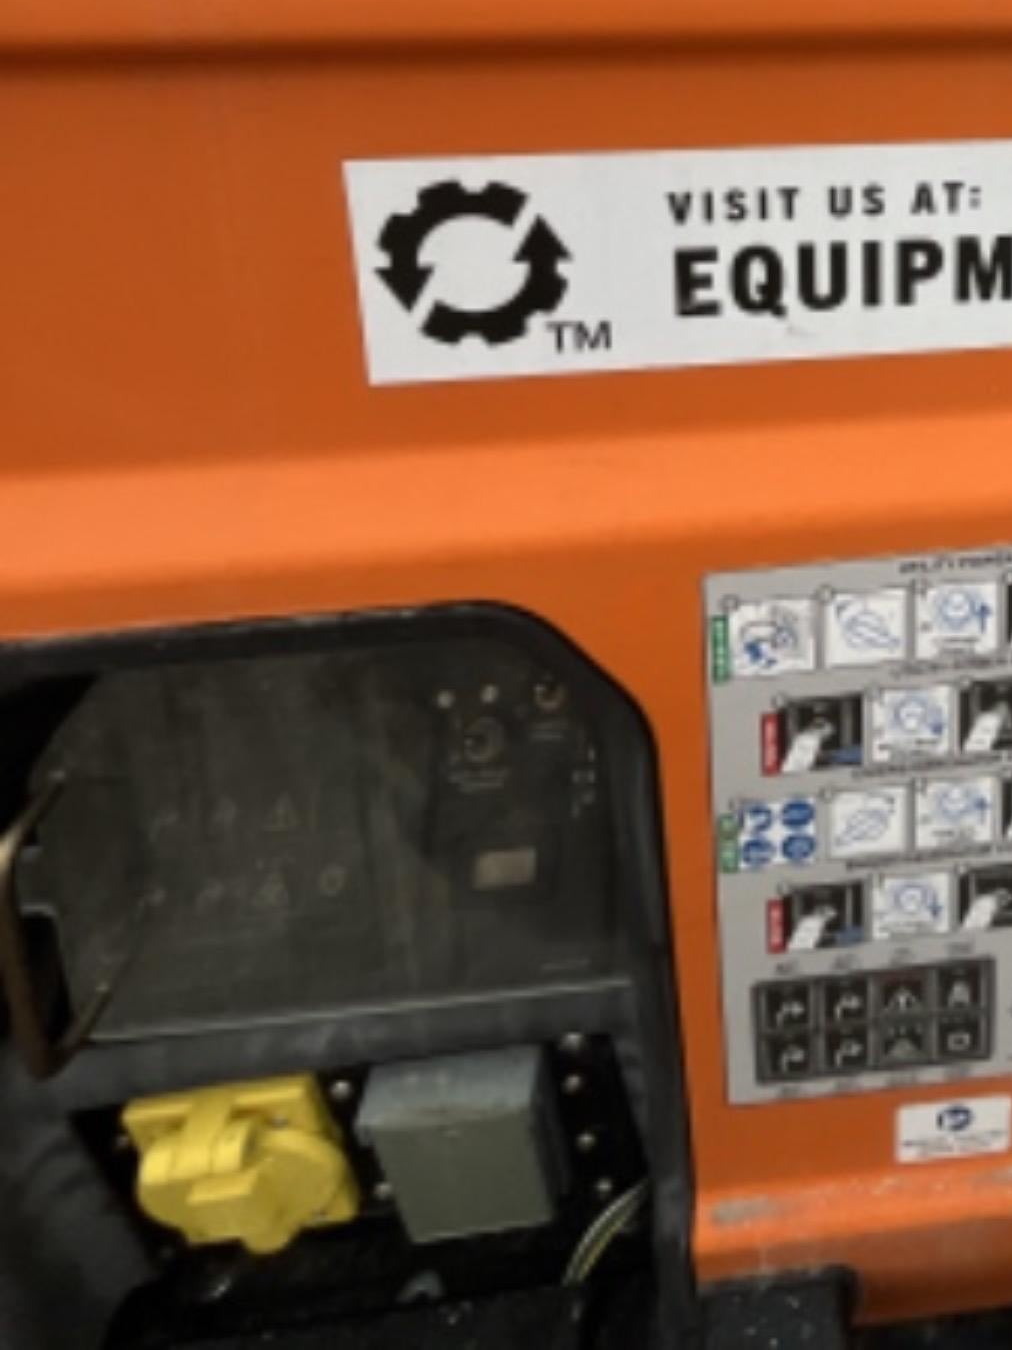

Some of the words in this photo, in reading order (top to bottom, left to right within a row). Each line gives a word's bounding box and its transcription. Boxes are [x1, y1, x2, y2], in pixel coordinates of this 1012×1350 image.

[667, 187, 801, 225] VISIT
[828, 185, 885, 218] US
[910, 182, 982, 215] AT:
[549, 321, 612, 353] TM
